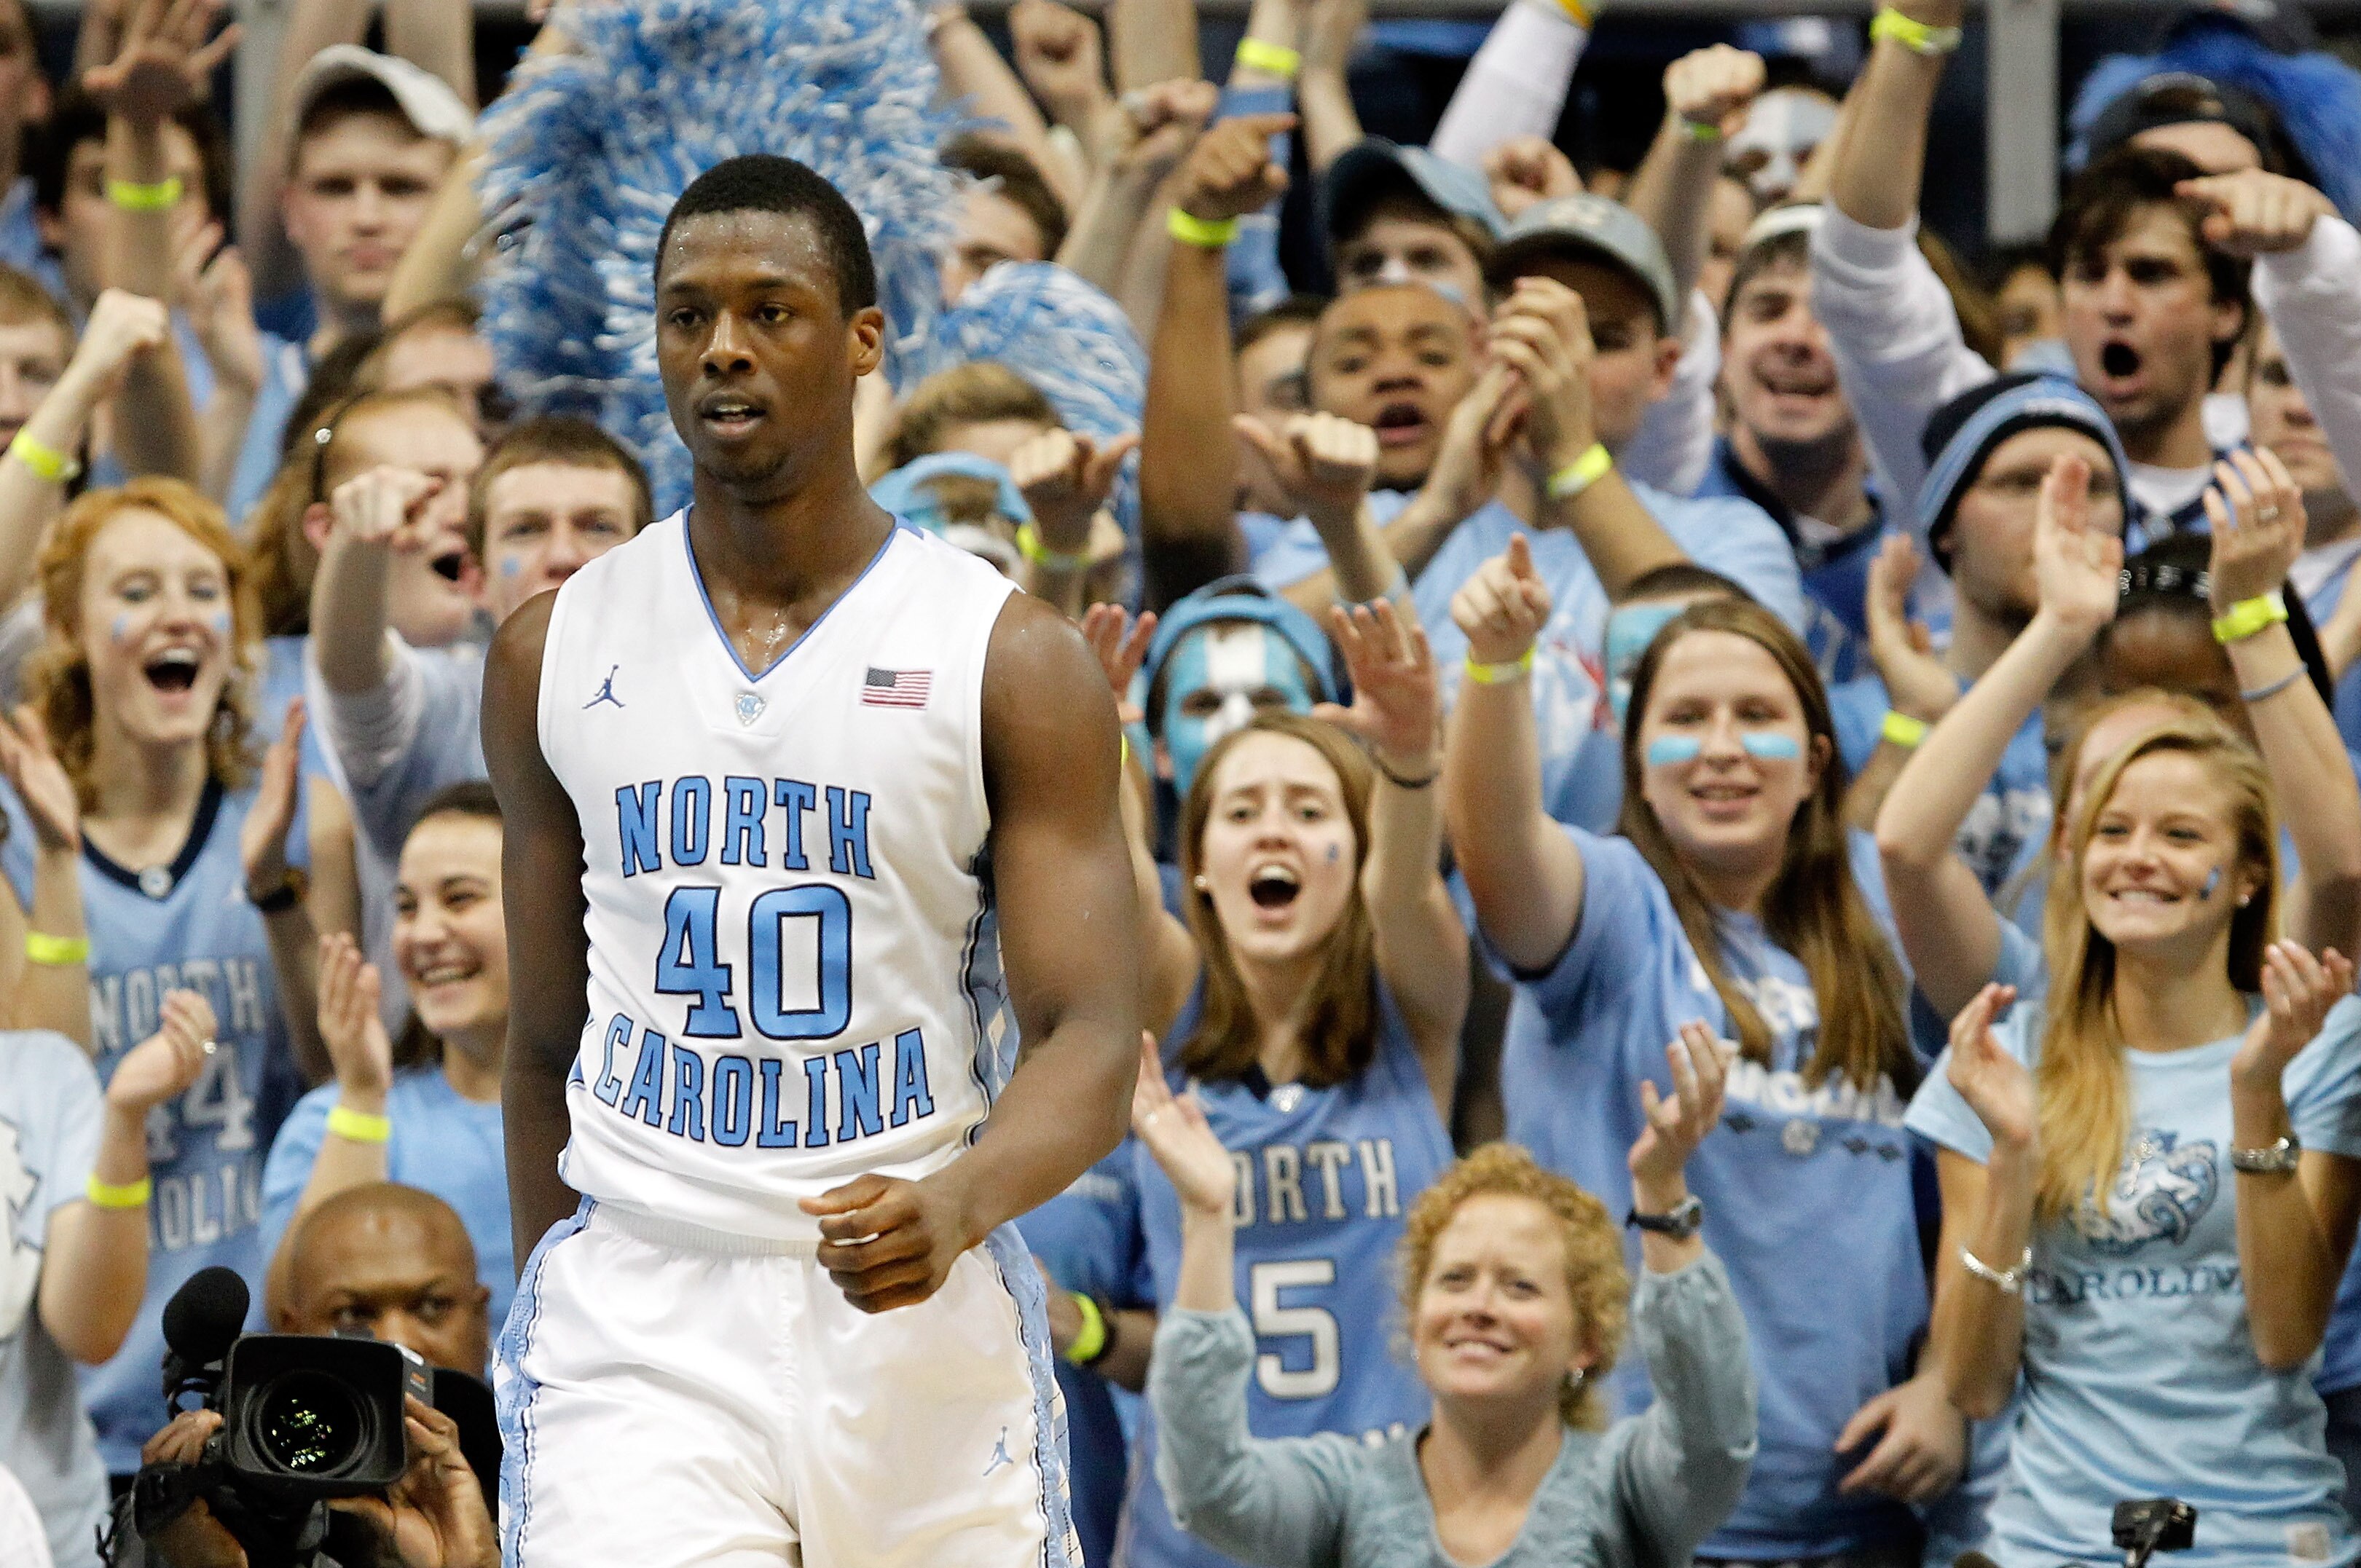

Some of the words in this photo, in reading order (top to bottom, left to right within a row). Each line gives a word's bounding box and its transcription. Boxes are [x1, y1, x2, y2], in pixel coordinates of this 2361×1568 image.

[616, 776, 876, 880] NORTH
[655, 883, 852, 1040] 40
[593, 1013, 935, 1149] CAROLINA
[1234, 1138, 1399, 1226] ORTH
[1252, 1260, 1340, 1397] 5
